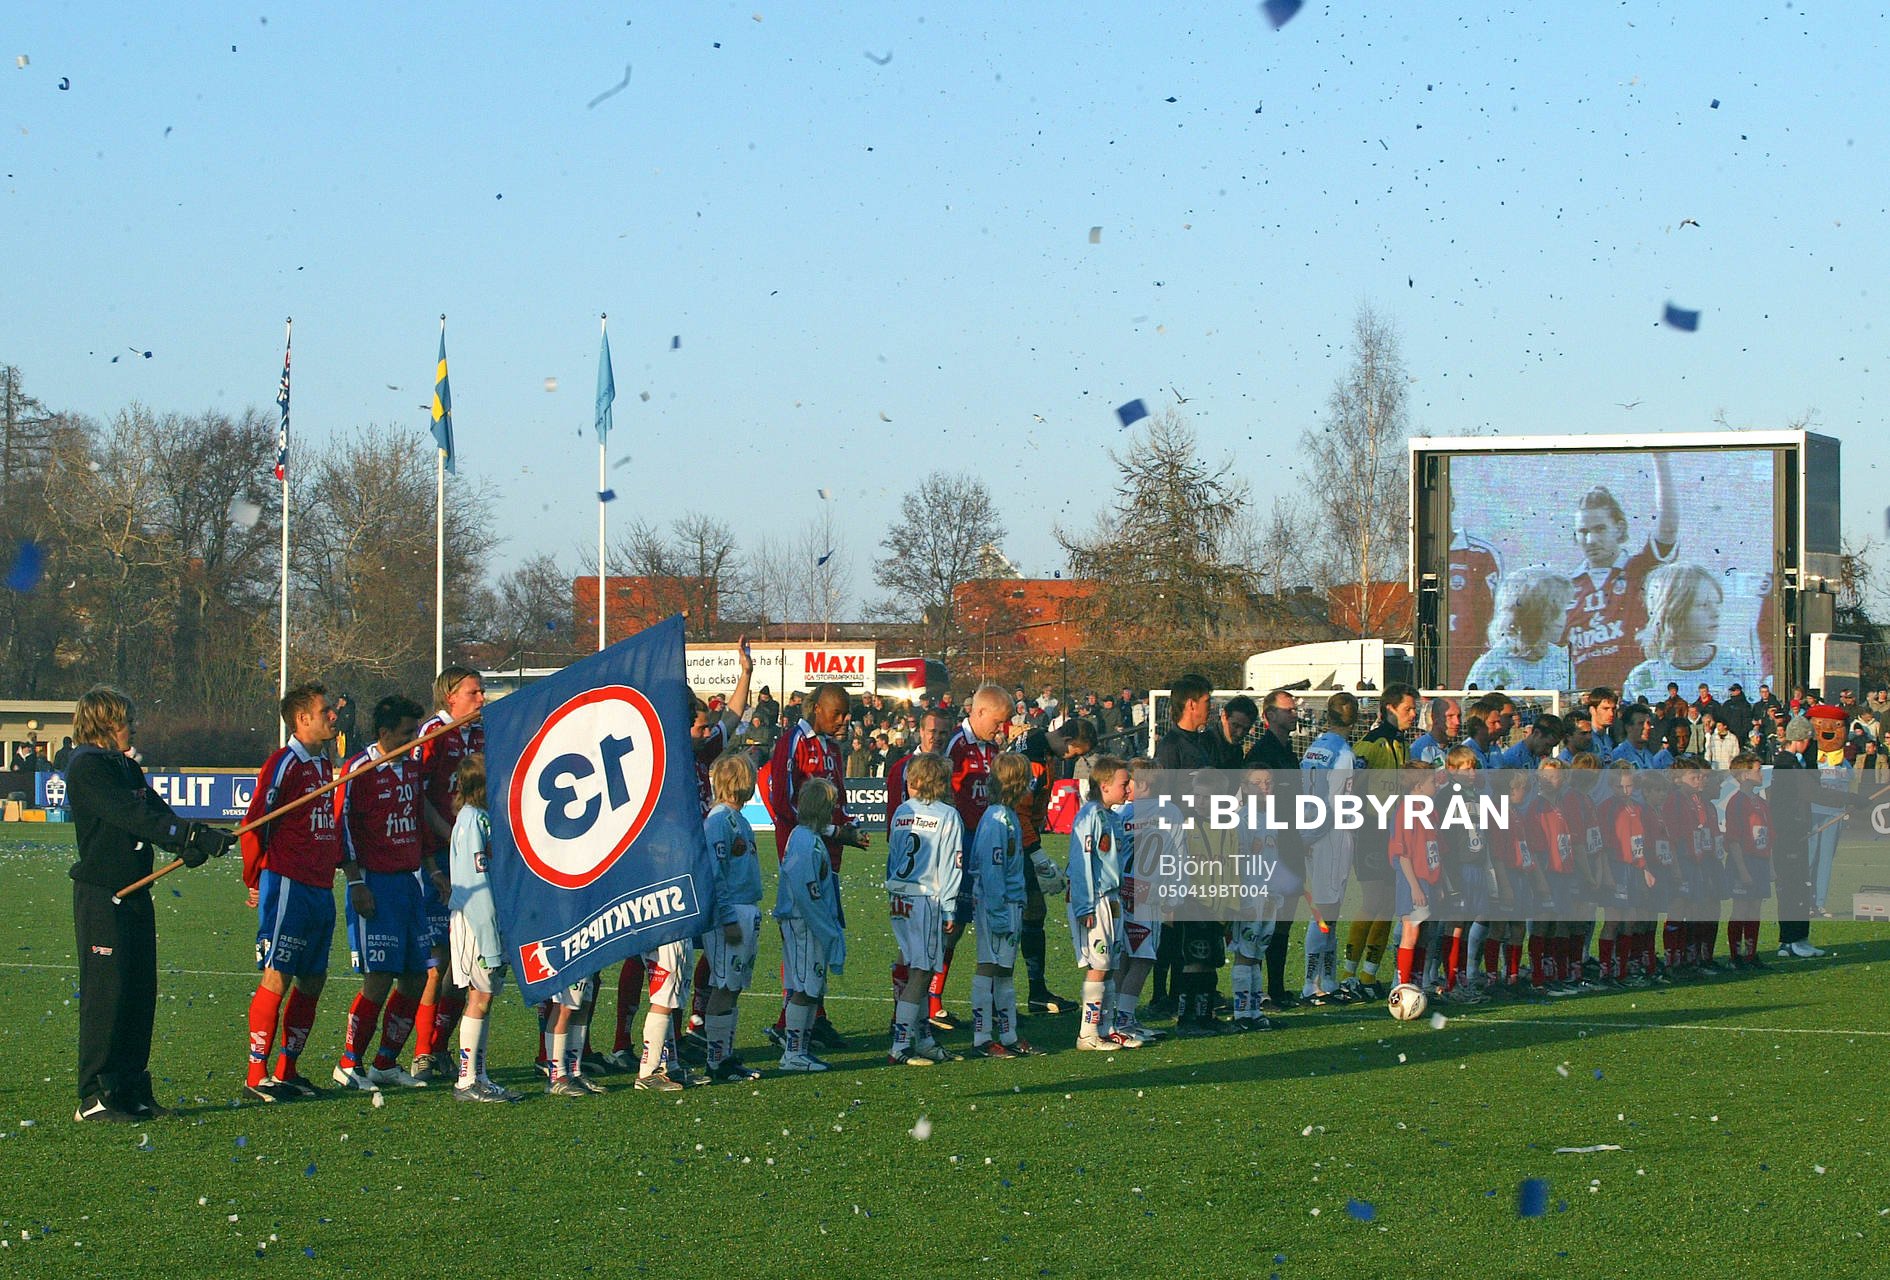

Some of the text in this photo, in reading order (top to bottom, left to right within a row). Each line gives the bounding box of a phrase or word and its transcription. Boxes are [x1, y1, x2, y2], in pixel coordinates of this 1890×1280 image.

[718, 656, 735, 666] kan
[760, 656, 772, 666] ha
[805, 652, 864, 673] MAXI
[693, 674, 706, 685] du
[823, 756, 834, 770] 10
[152, 777, 215, 807] ELIT
[396, 784, 413, 802] 20
[309, 807, 335, 832] fina
[867, 814, 885, 822] YOU
[896, 833, 921, 879] 3
[275, 948, 292, 962] 23
[369, 949, 386, 962] 20
